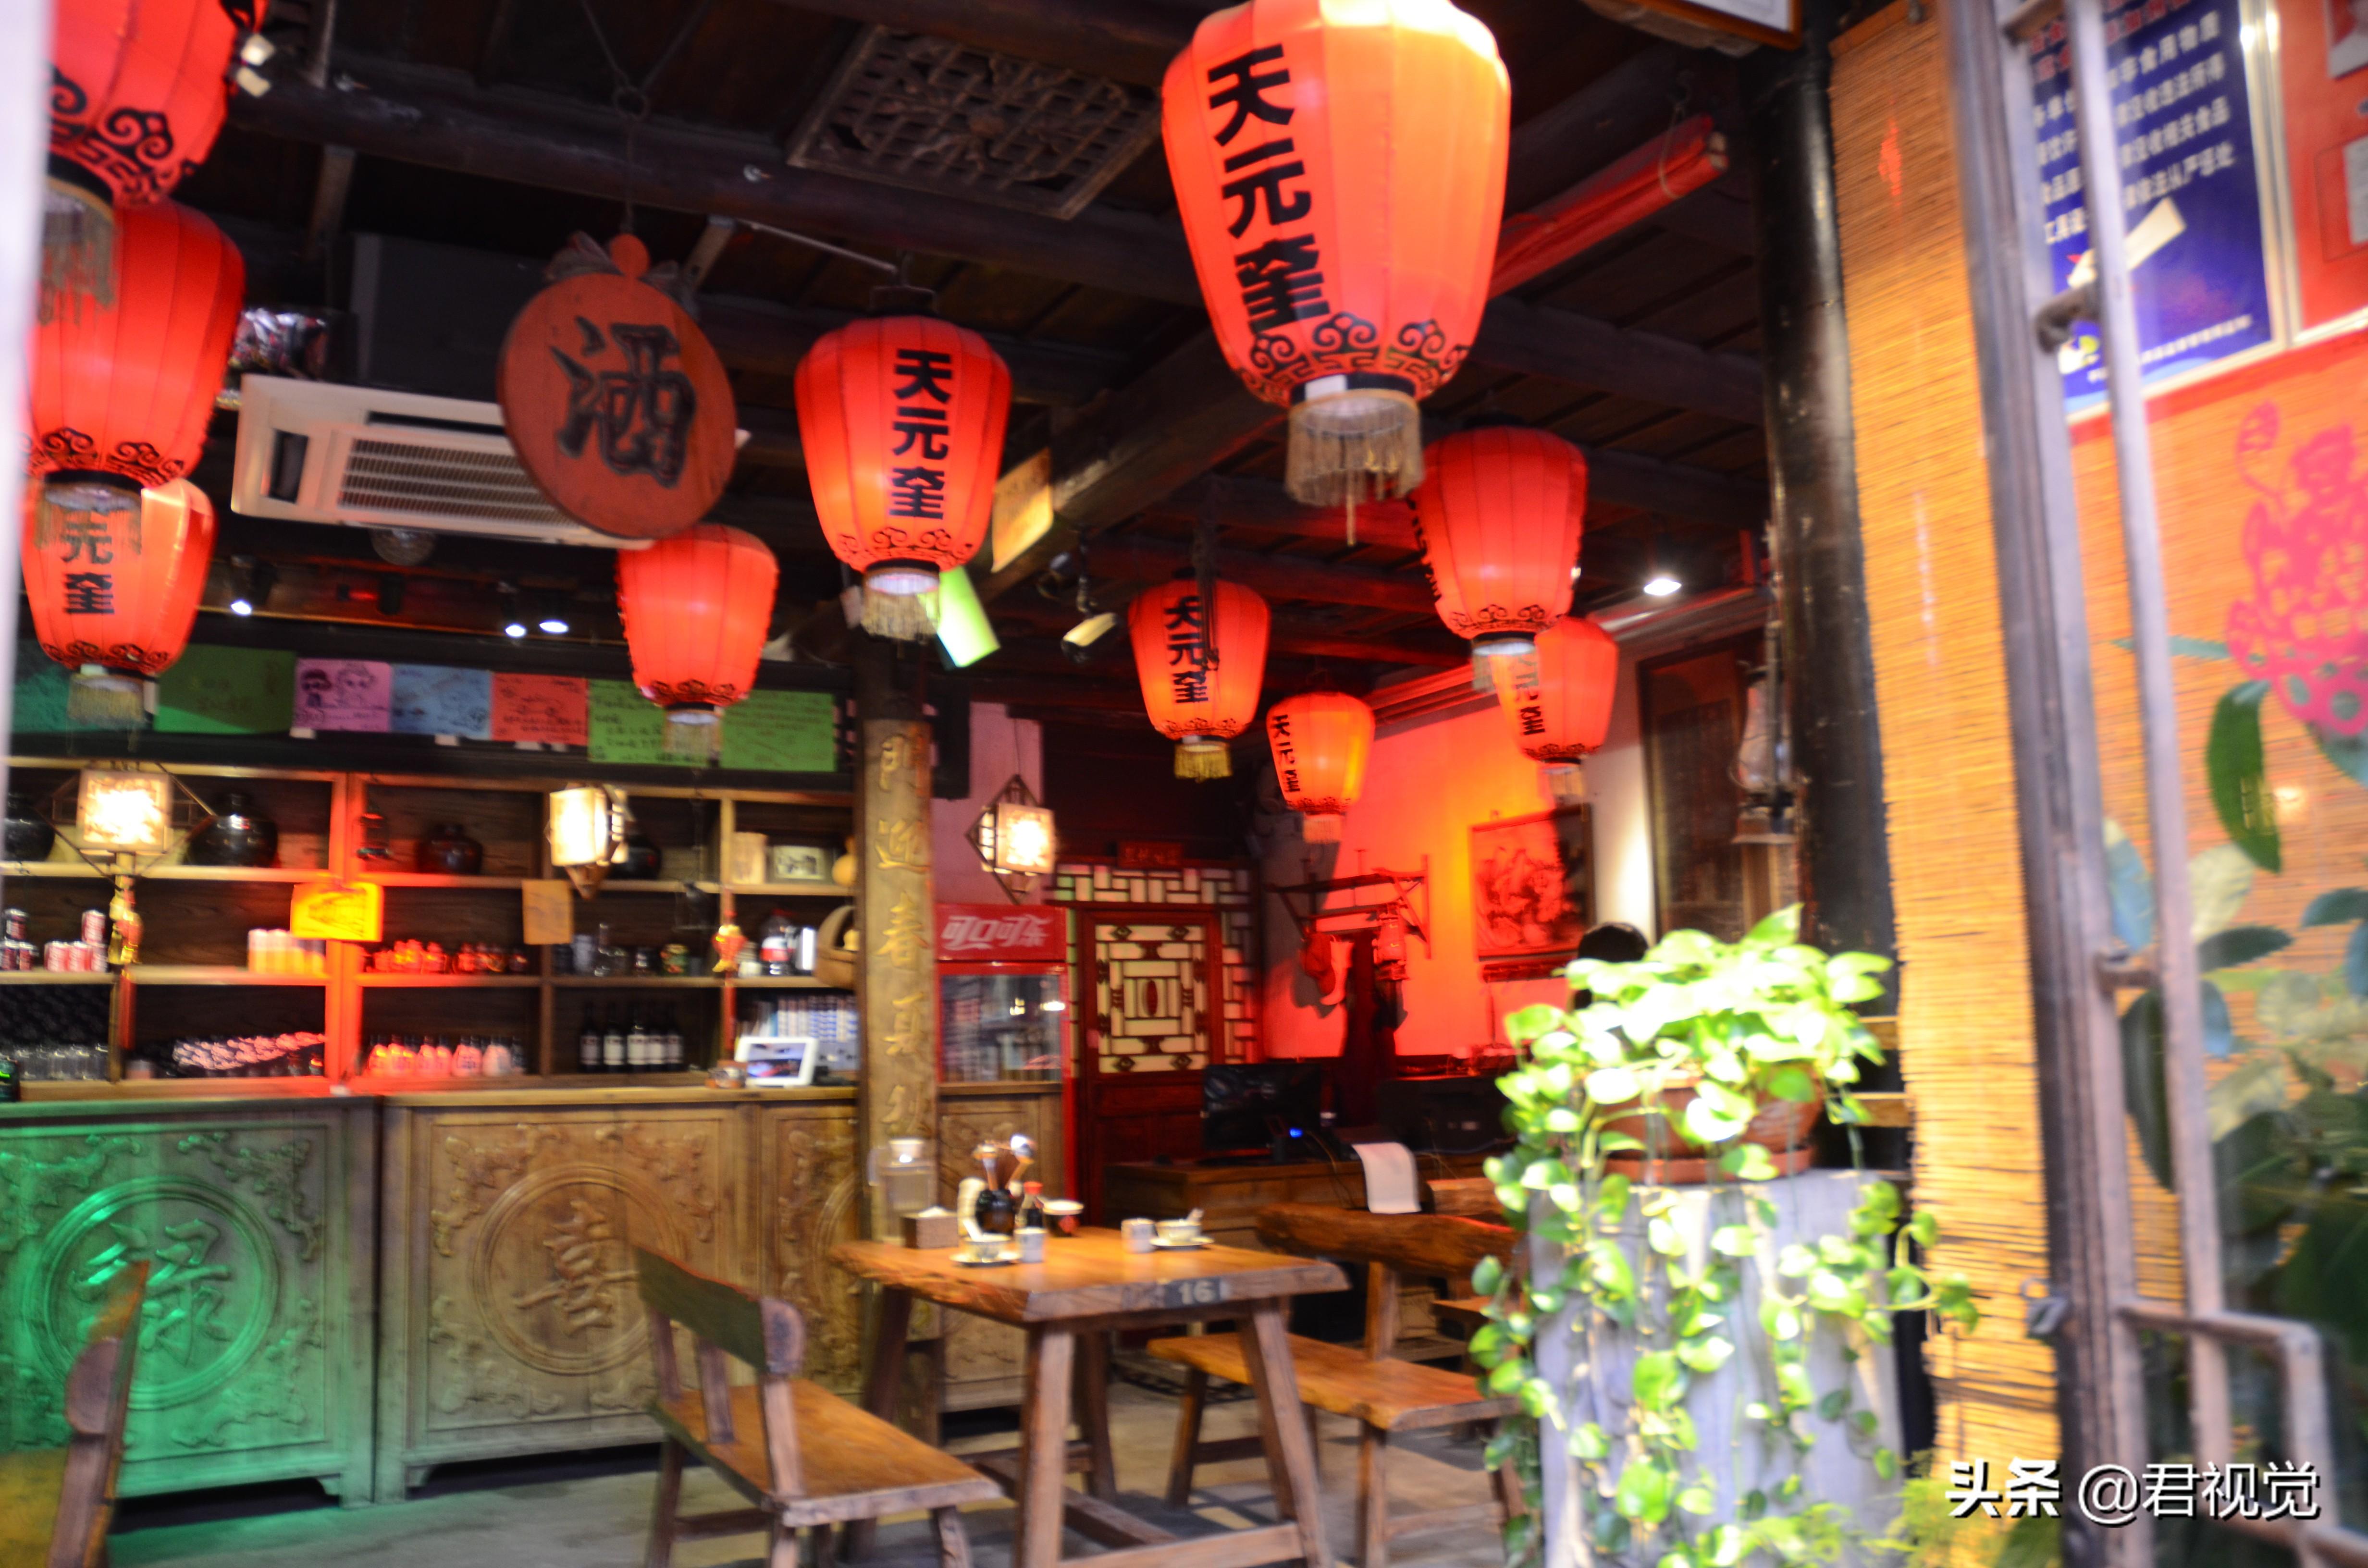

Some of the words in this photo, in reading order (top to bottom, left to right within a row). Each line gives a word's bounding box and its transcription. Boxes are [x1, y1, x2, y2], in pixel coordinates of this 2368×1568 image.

[1207, 43, 1330, 334] 天元奎
[888, 348, 952, 520] 天元奎
[61, 511, 115, 615] 元奎
[1178, 1279, 1216, 1306] 16
